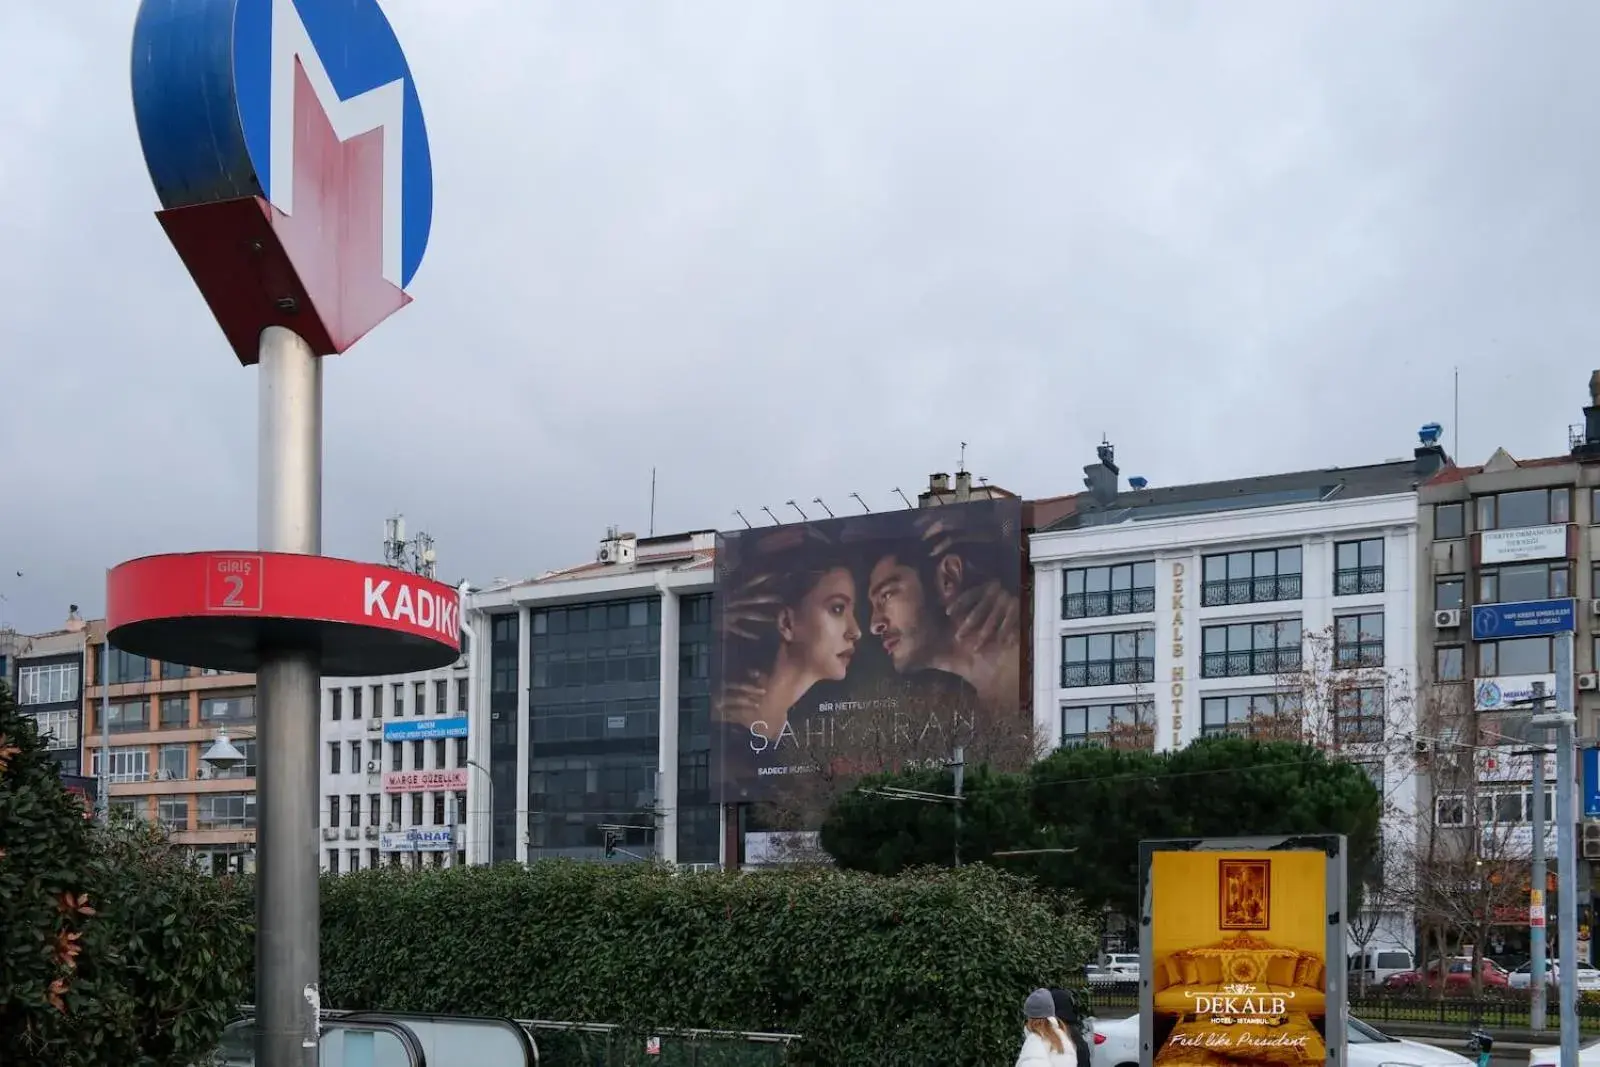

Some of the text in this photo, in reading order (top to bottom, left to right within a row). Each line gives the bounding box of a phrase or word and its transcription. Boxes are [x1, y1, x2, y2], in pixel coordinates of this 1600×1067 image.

[217, 560, 251, 575] GİRİŞ
[223, 575, 244, 607] 2
[1171, 562, 1184, 746] DEKALB HOTEL
[819, 702, 834, 712] BİR
[750, 710, 975, 754] ŞAHMARAN
[758, 766, 788, 776] SADECE
[406, 832, 450, 842] BAHAR
[1196, 997, 1286, 1015] DEKALB
[1169, 1031, 1311, 1048] Feel like President
